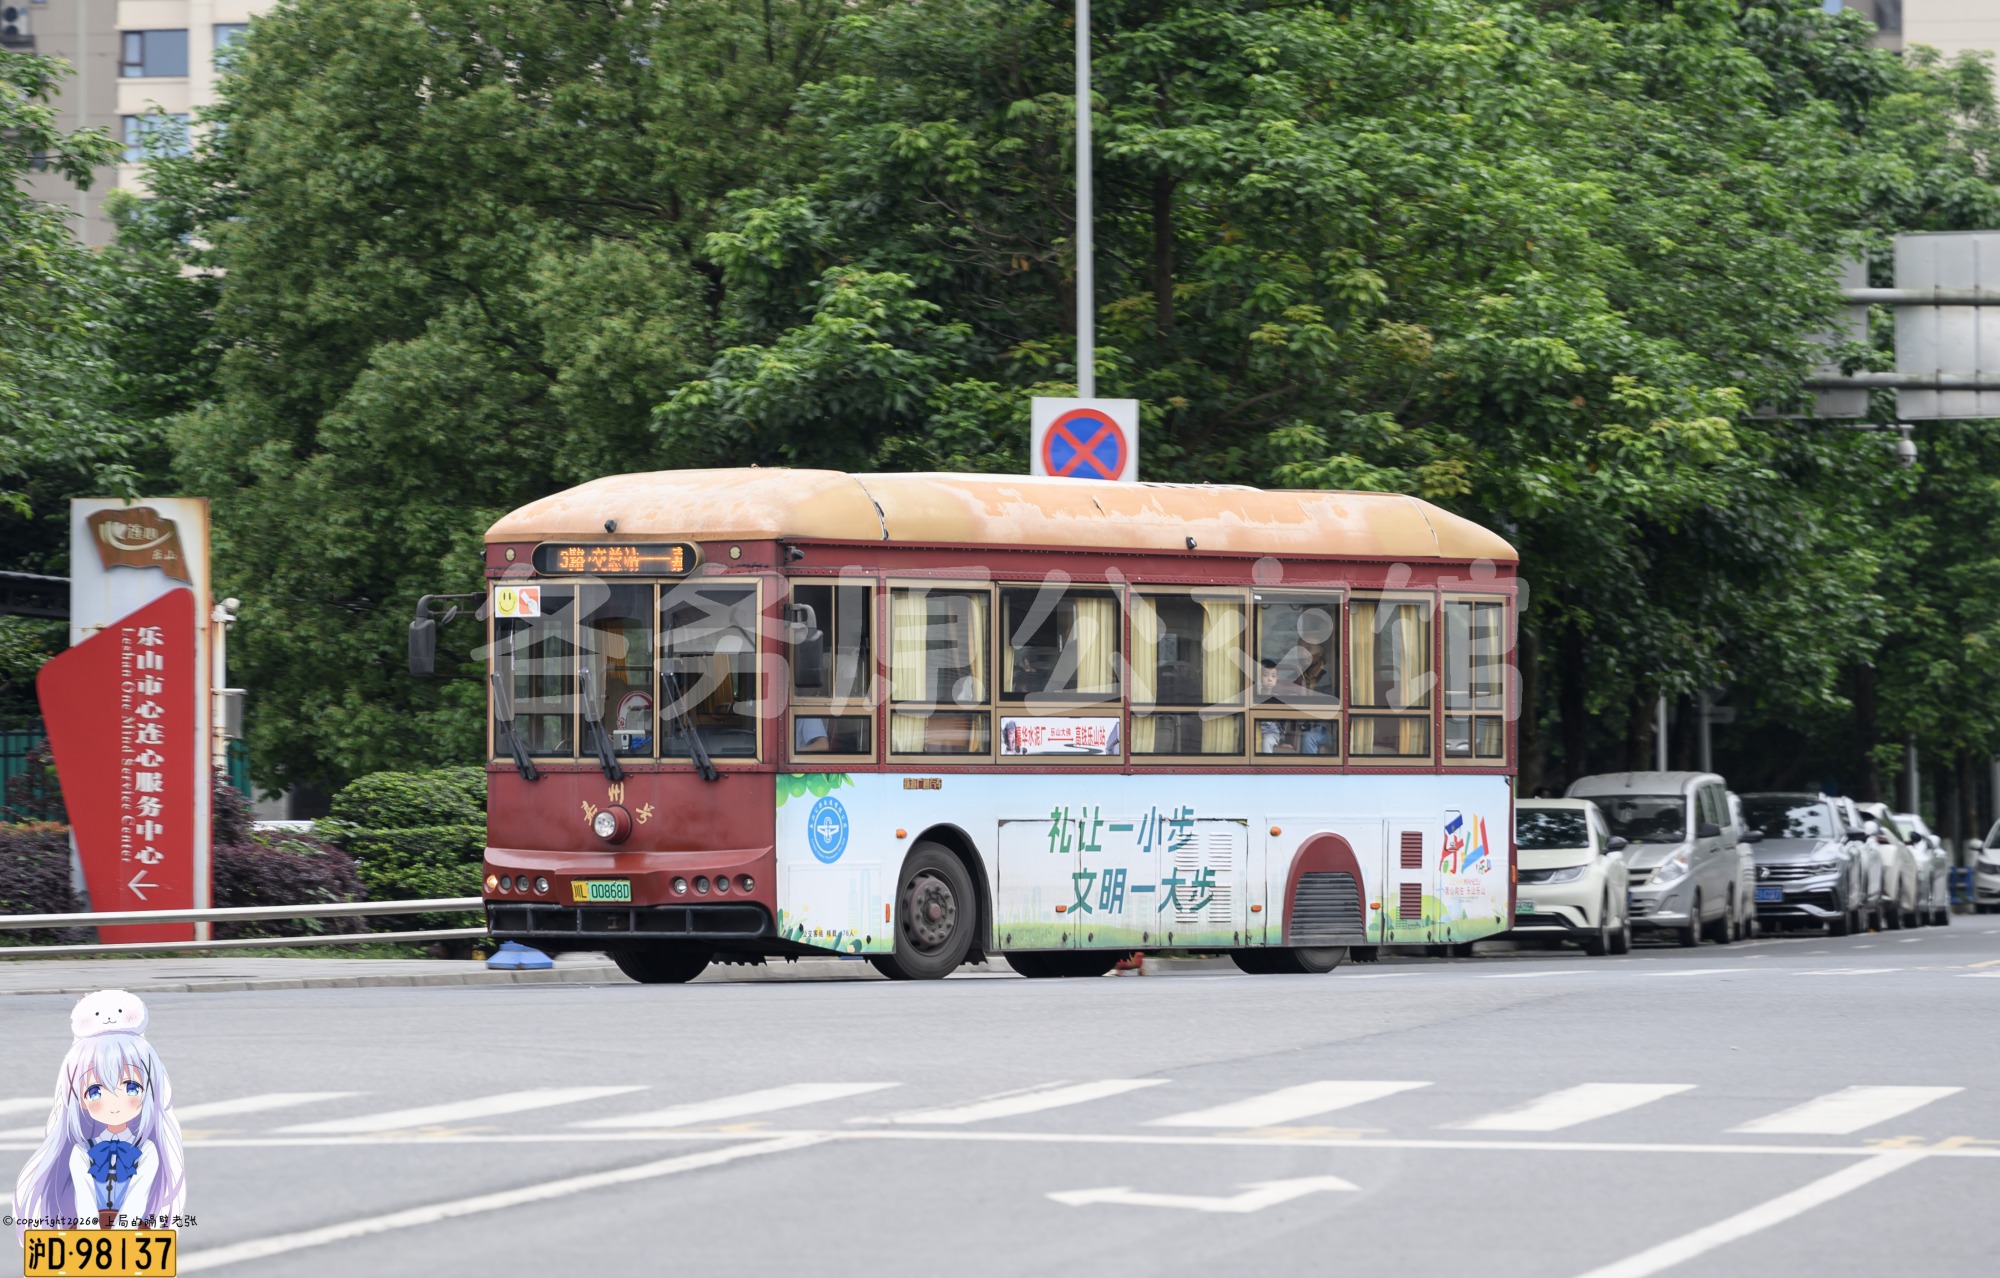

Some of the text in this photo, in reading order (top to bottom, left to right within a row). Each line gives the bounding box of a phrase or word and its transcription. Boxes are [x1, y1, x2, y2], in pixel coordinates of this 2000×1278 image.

[121, 628, 136, 862] Leshan One Mind Service Center
[135, 626, 165, 865] 乐山市心连心服务中心
[1075, 726, 1106, 746] 高铁乐山站
[1048, 805, 1195, 853] 礼让一小步
[573, 884, 630, 899] 川L00868D
[1067, 866, 1216, 915] 文明一大步
